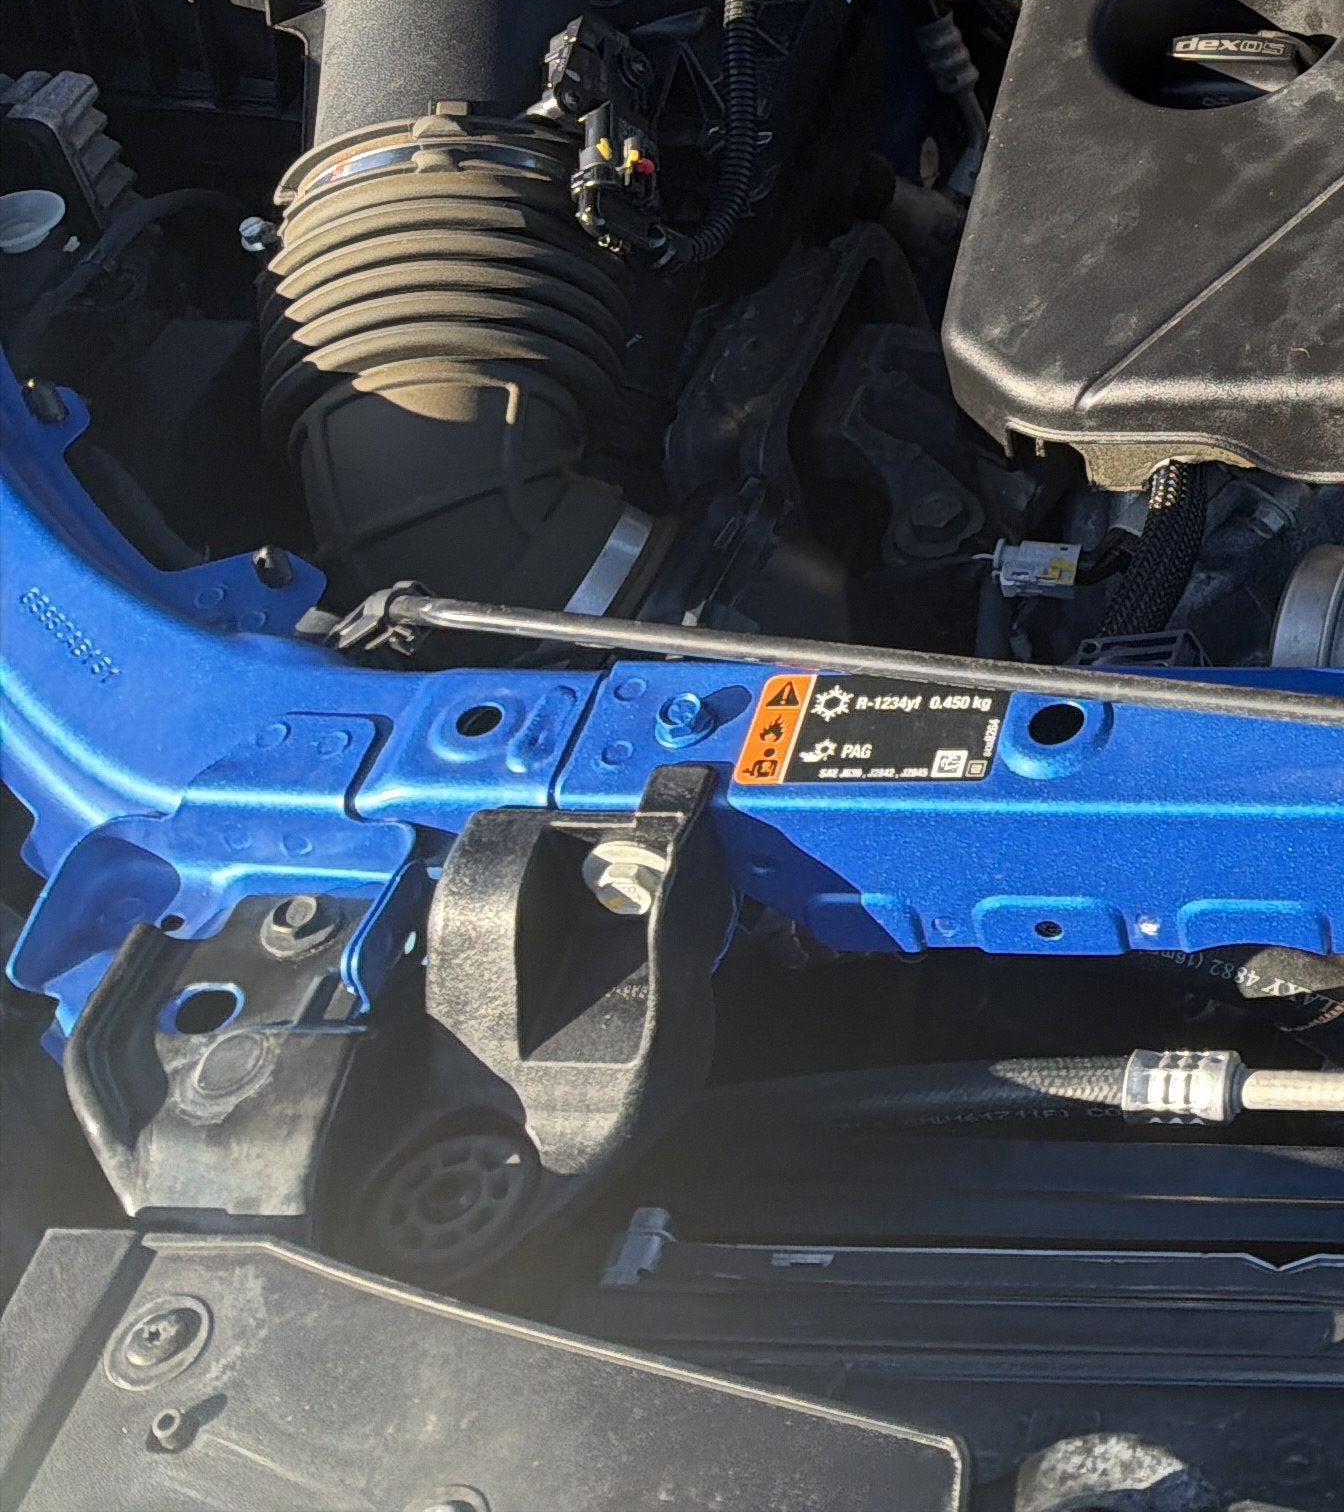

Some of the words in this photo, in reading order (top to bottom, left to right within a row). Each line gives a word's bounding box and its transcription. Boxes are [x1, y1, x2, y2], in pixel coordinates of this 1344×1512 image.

[855, 695, 922, 712] R-1234yf
[929, 695, 970, 710] 0.450
[972, 695, 992, 711] kg
[841, 743, 872, 759] PAG
[1209, 958, 1260, 985] 4882
